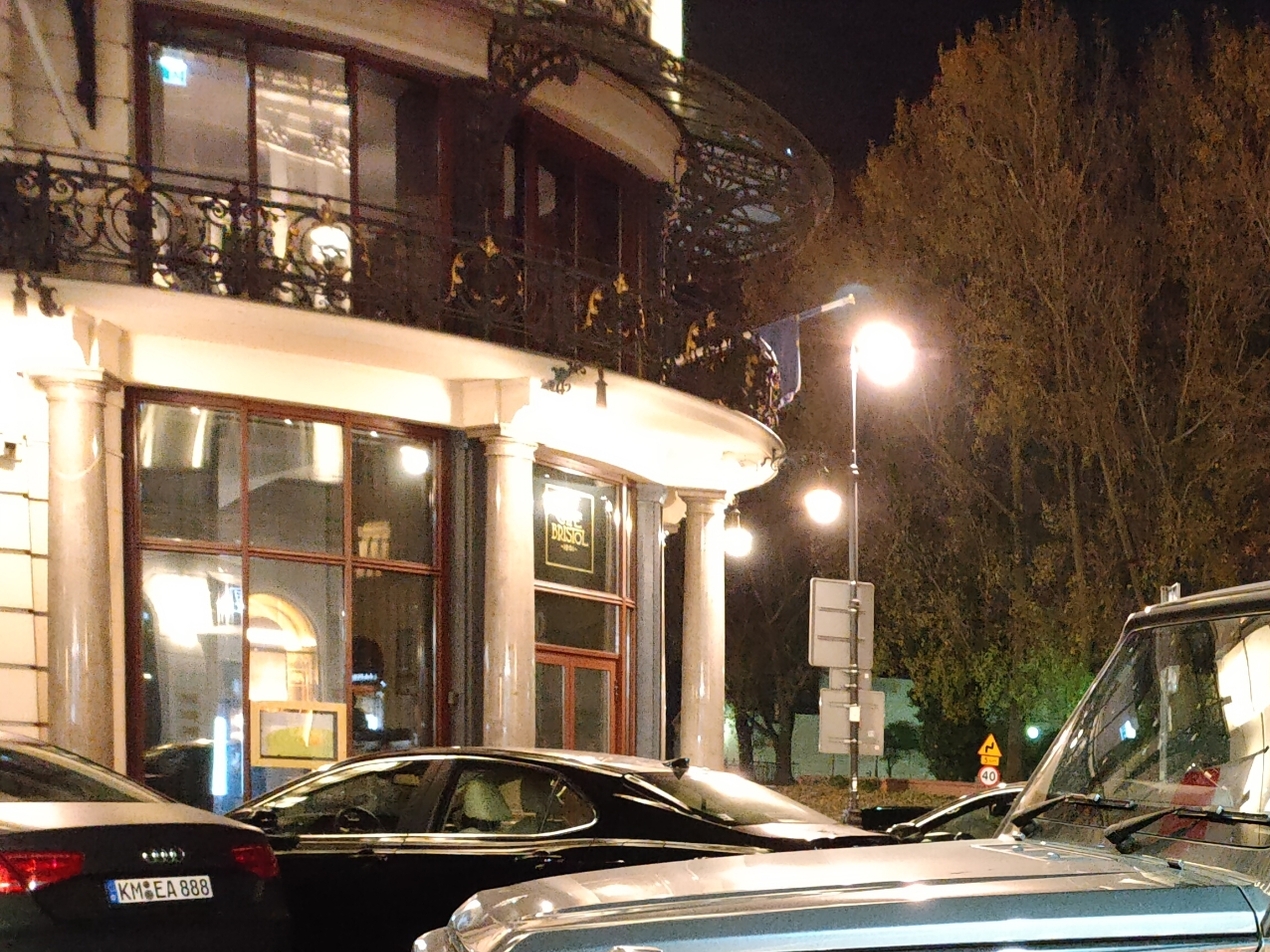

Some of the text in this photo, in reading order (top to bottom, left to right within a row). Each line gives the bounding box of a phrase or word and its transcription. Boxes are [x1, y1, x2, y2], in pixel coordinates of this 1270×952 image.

[551, 522, 589, 547] BRISTOL
[982, 770, 996, 782] 40
[117, 878, 210, 901] KM EA 888
